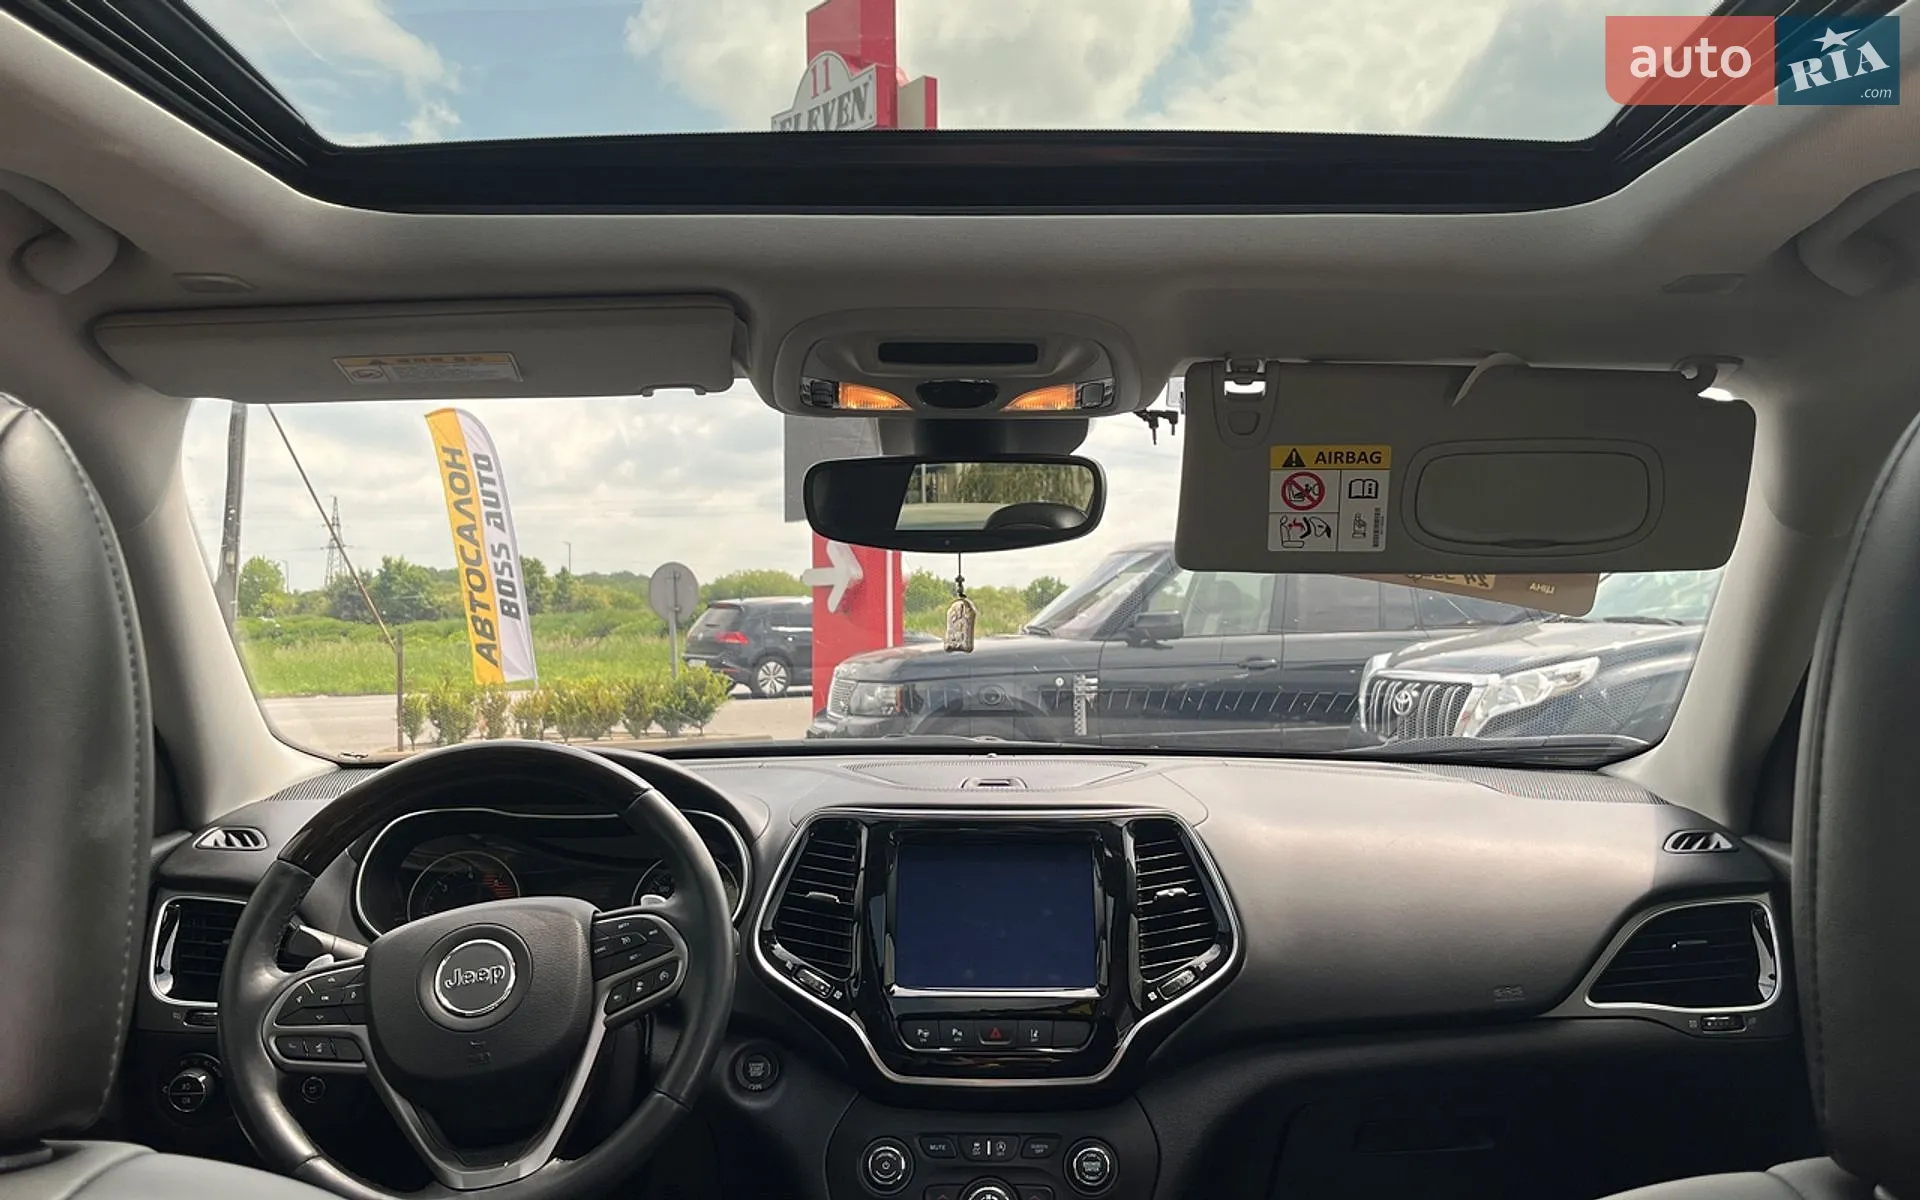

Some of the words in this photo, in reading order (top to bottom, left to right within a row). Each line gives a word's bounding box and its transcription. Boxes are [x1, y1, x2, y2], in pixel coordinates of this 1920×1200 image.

[473, 453, 506, 534] AUTO
[1314, 450, 1383, 465] AIRBAG
[441, 446, 499, 668] АВТОСАЛОН
[493, 542, 521, 621] BOSS
[444, 964, 506, 989] Jeep
